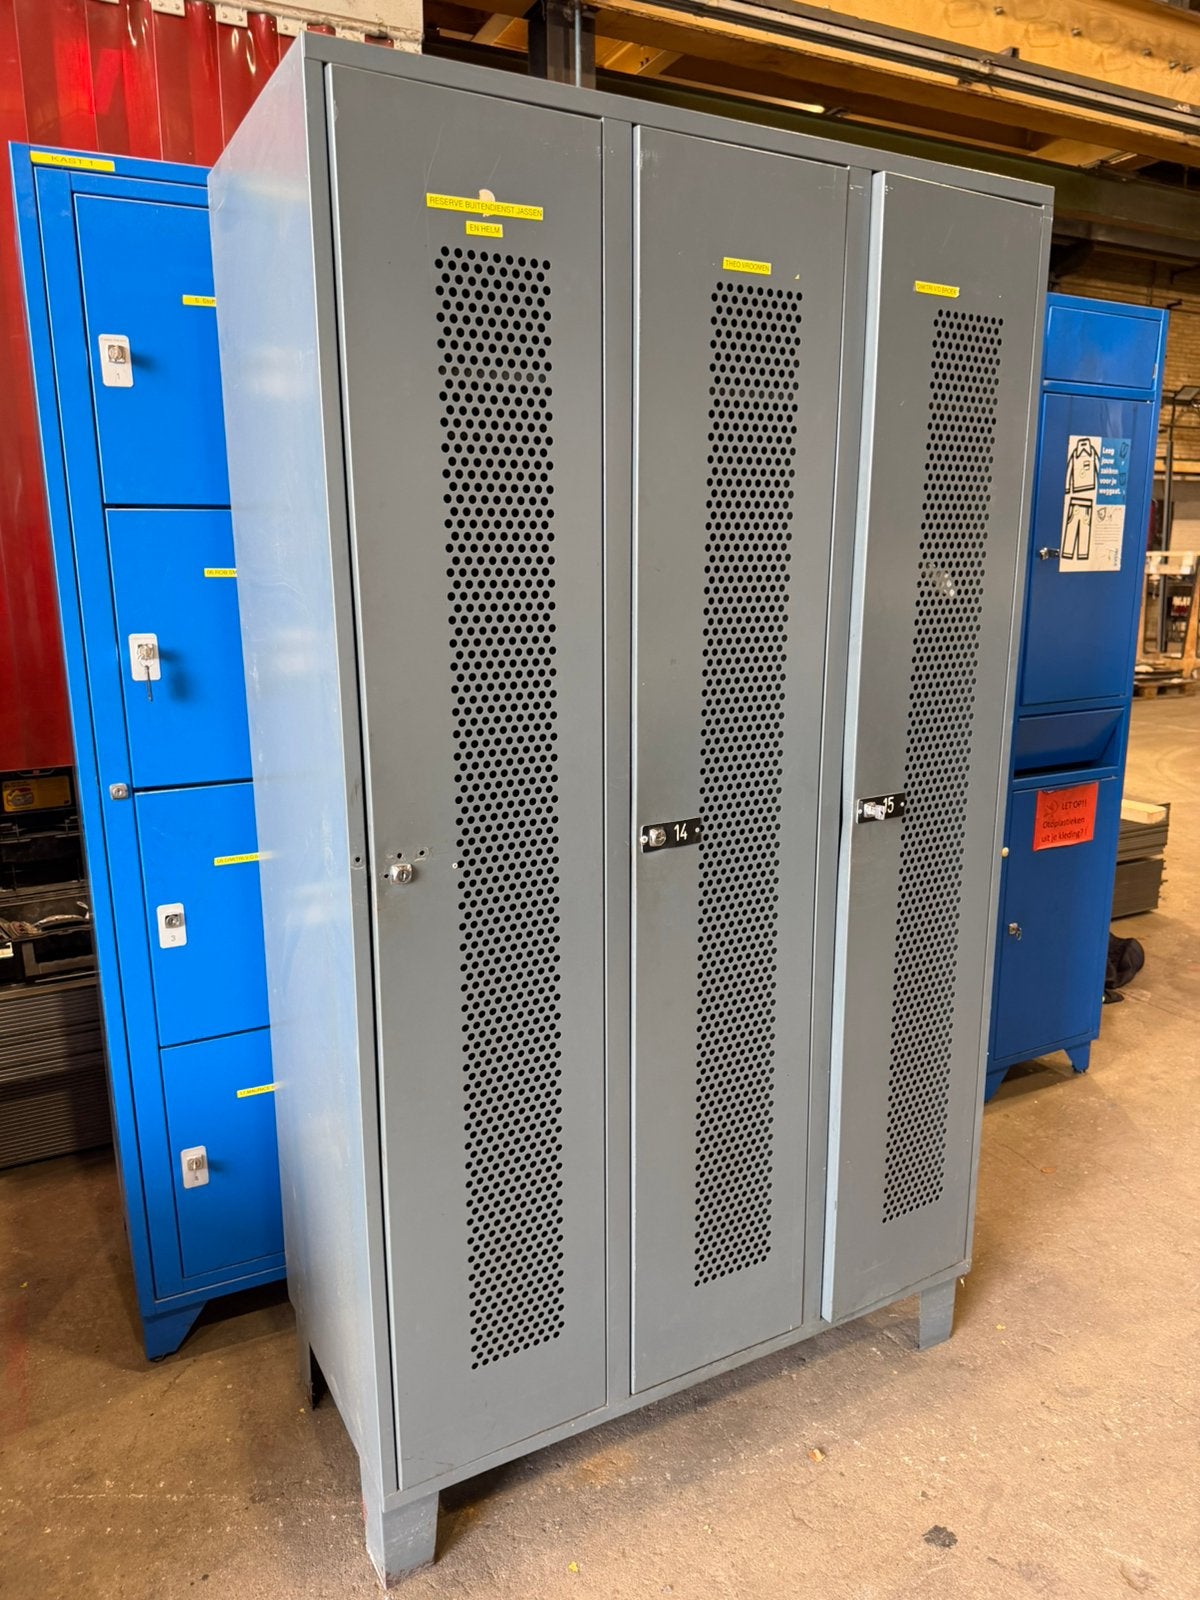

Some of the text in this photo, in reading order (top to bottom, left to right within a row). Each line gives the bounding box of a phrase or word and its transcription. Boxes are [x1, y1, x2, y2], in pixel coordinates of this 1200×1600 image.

[51, 155, 83, 165] KAST
[429, 196, 543, 217] RESERVE BUITENDIENST JASSEN
[469, 224, 500, 234] EN HELM
[725, 259, 741, 268] THEO
[1102, 446, 1115, 456] Leeg
[1101, 457, 1115, 466] jouw
[882, 796, 895, 814] 15
[1061, 801, 1073, 811] LET
[674, 823, 688, 842] 14
[1041, 834, 1050, 843] uit
[1050, 833, 1058, 843] je
[170, 934, 177, 943] 3
